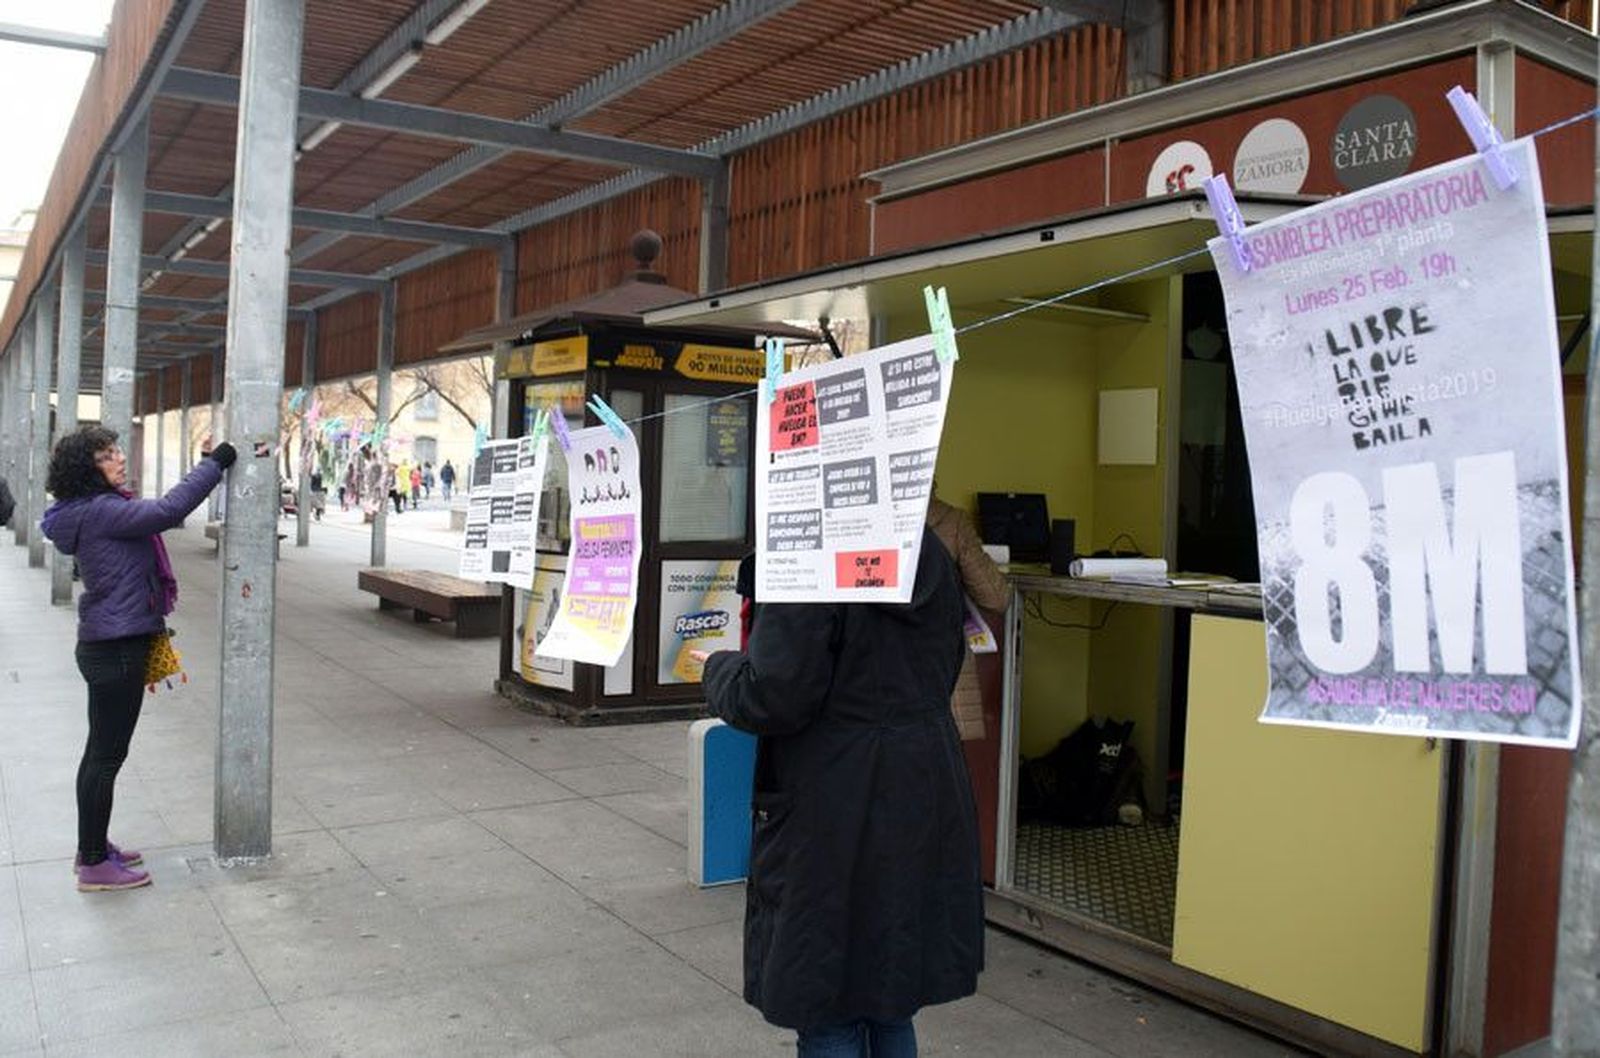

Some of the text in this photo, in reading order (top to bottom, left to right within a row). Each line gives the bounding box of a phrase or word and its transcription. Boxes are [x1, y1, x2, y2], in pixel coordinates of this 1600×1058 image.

[1335, 119, 1415, 150] SANTA
[1237, 156, 1306, 183] ZAMORA
[1334, 139, 1413, 169] CLARA
[1335, 169, 1488, 246] PREPARATORIA
[1398, 221, 1454, 256] planta
[1285, 251, 1456, 315] Lunes 25 Feb. 19h
[1325, 303, 1436, 356] LIBRE
[688, 360, 705, 372] 90
[1332, 345, 1418, 384] LA QUE
[1352, 417, 1432, 451] BAILA
[1289, 451, 1528, 675] 8M
[676, 612, 728, 632] Rascas
[1307, 676, 1388, 707] ASAMBLEA
[1391, 681, 1412, 708] DE
[1418, 682, 1504, 713] MUJERES
